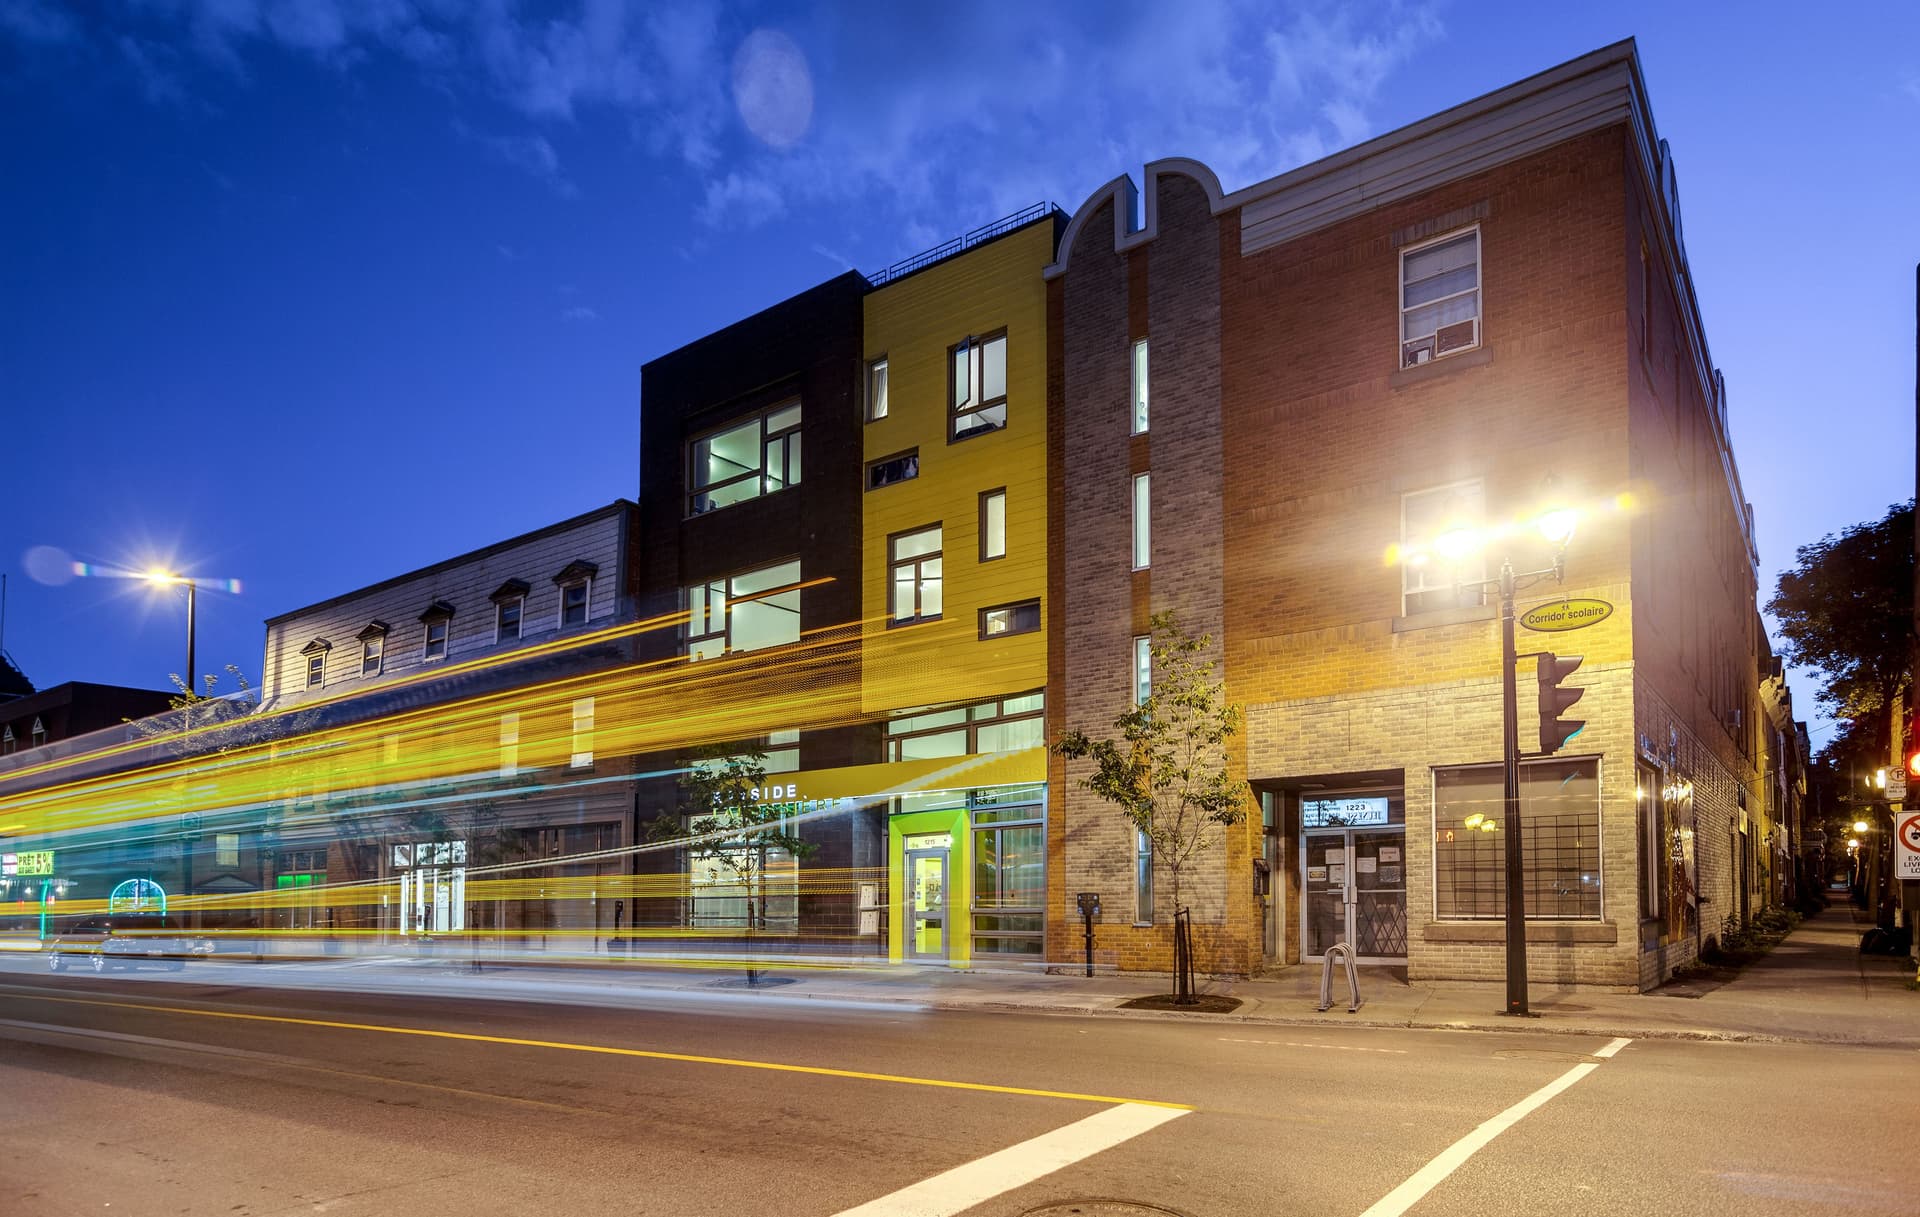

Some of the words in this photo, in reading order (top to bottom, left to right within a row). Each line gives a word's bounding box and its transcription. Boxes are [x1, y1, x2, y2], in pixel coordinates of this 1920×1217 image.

[1529, 612, 1565, 624] Corridor
[1568, 607, 1604, 618] scolaire
[18, 854, 35, 866] PRÊT
[36, 853, 51, 873] 5%
